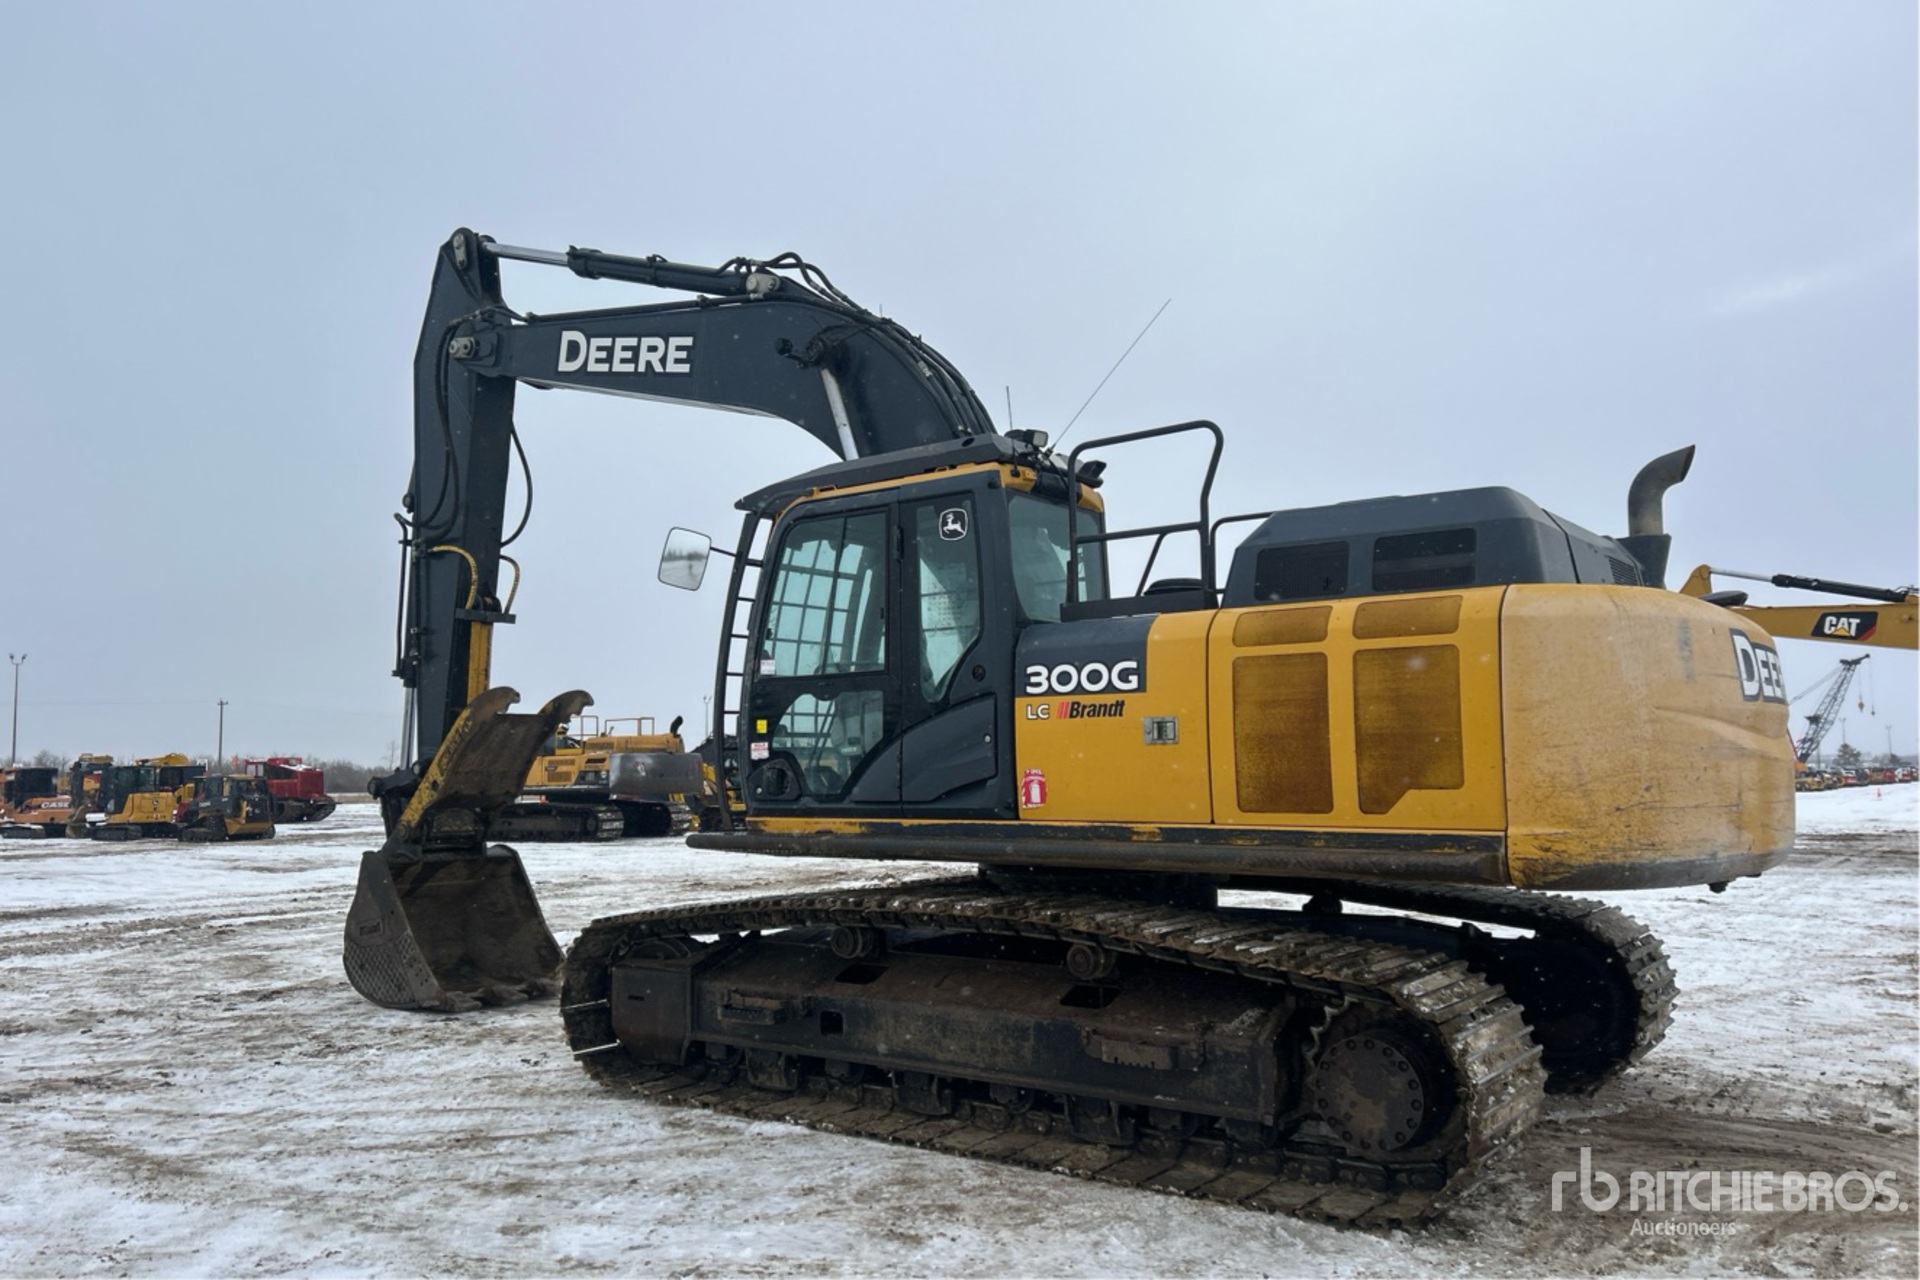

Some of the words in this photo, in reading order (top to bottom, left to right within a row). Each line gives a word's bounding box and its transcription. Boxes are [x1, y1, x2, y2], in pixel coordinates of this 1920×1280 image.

[557, 330, 694, 373] DEERE
[1823, 615, 1860, 637] CAT
[1025, 661, 1139, 694] 300G
[1732, 634, 1786, 698] DEE
[1026, 704, 1050, 720] LC
[1068, 700, 1126, 719] Brandt
